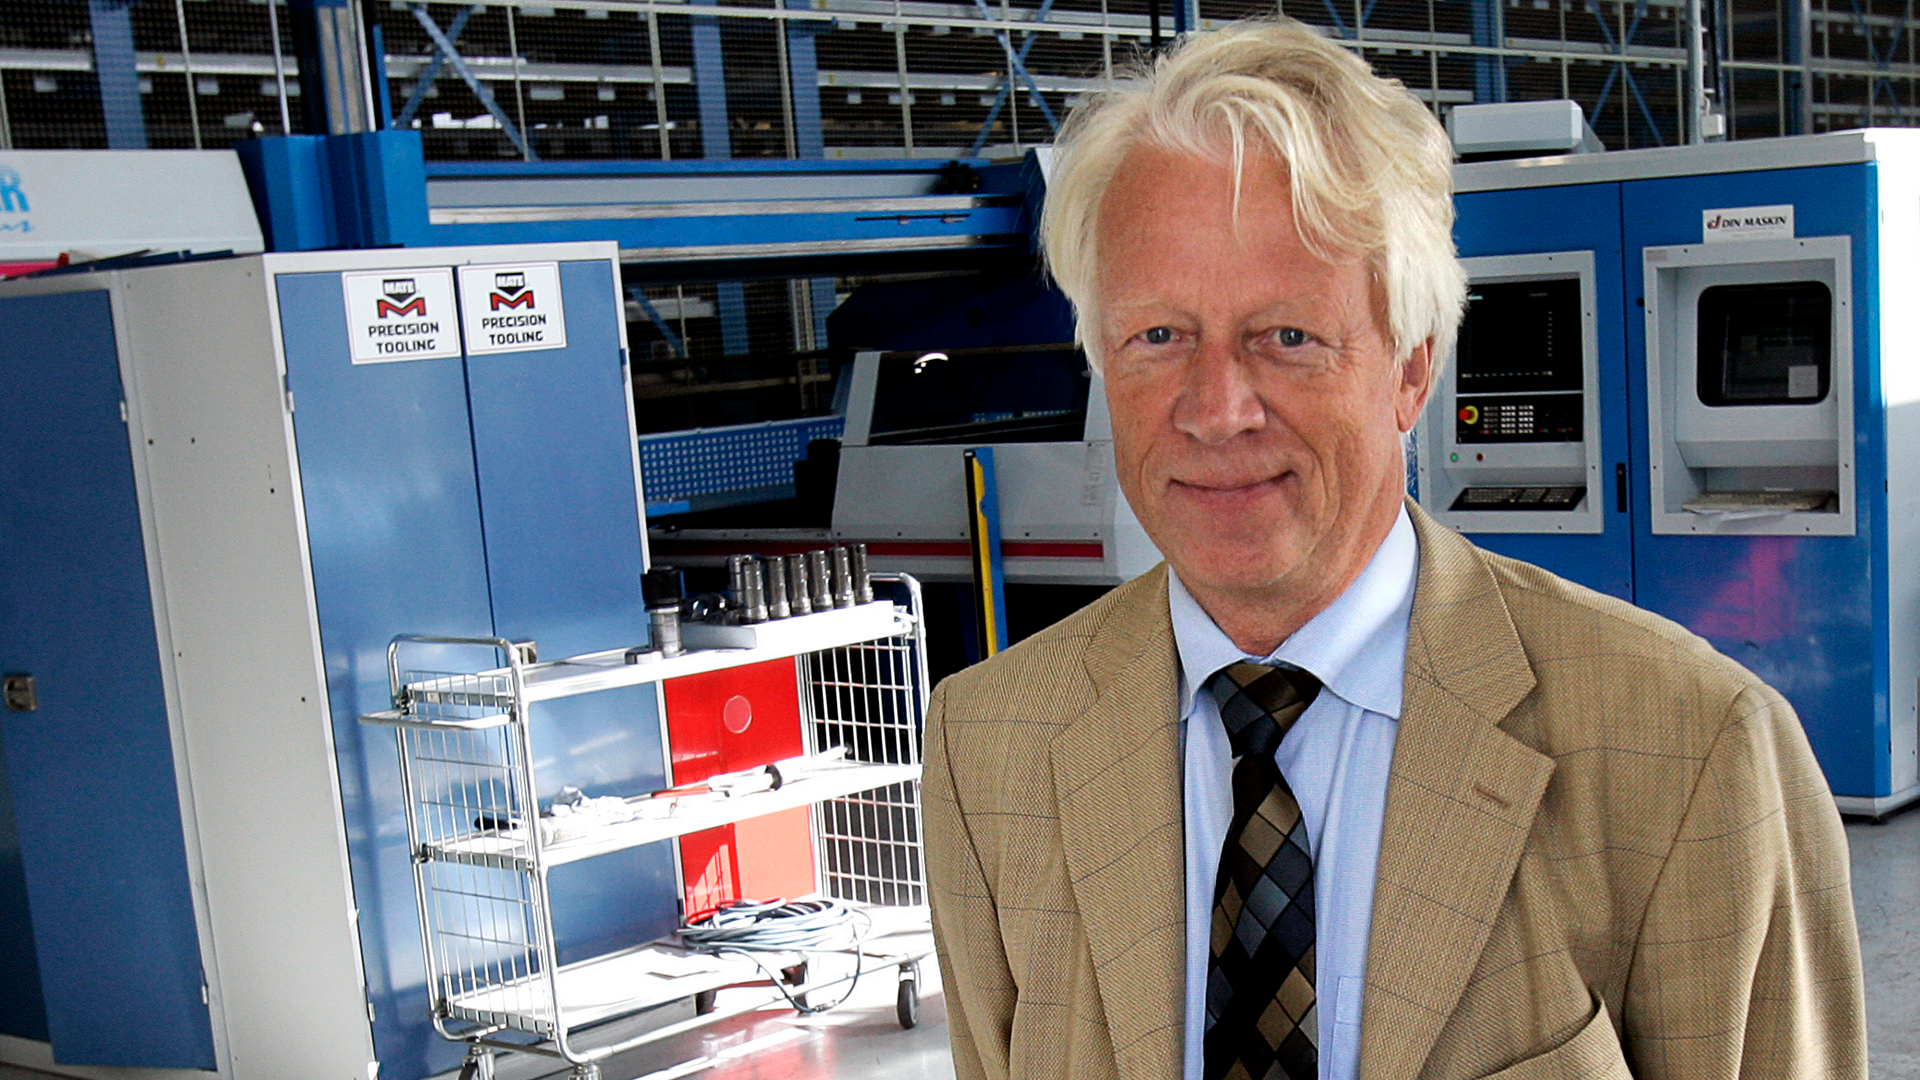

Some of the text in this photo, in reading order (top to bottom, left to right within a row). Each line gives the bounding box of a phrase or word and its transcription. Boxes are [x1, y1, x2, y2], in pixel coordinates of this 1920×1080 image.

[0, 166, 30, 212] R
[1744, 215, 1787, 226] MASKIN
[384, 281, 414, 294] MATE
[496, 275, 525, 288] MATE
[482, 314, 546, 329] PRECISION
[369, 322, 439, 337] PRECISION
[489, 331, 544, 345] TOOLING
[377, 339, 436, 354] TOOLING
